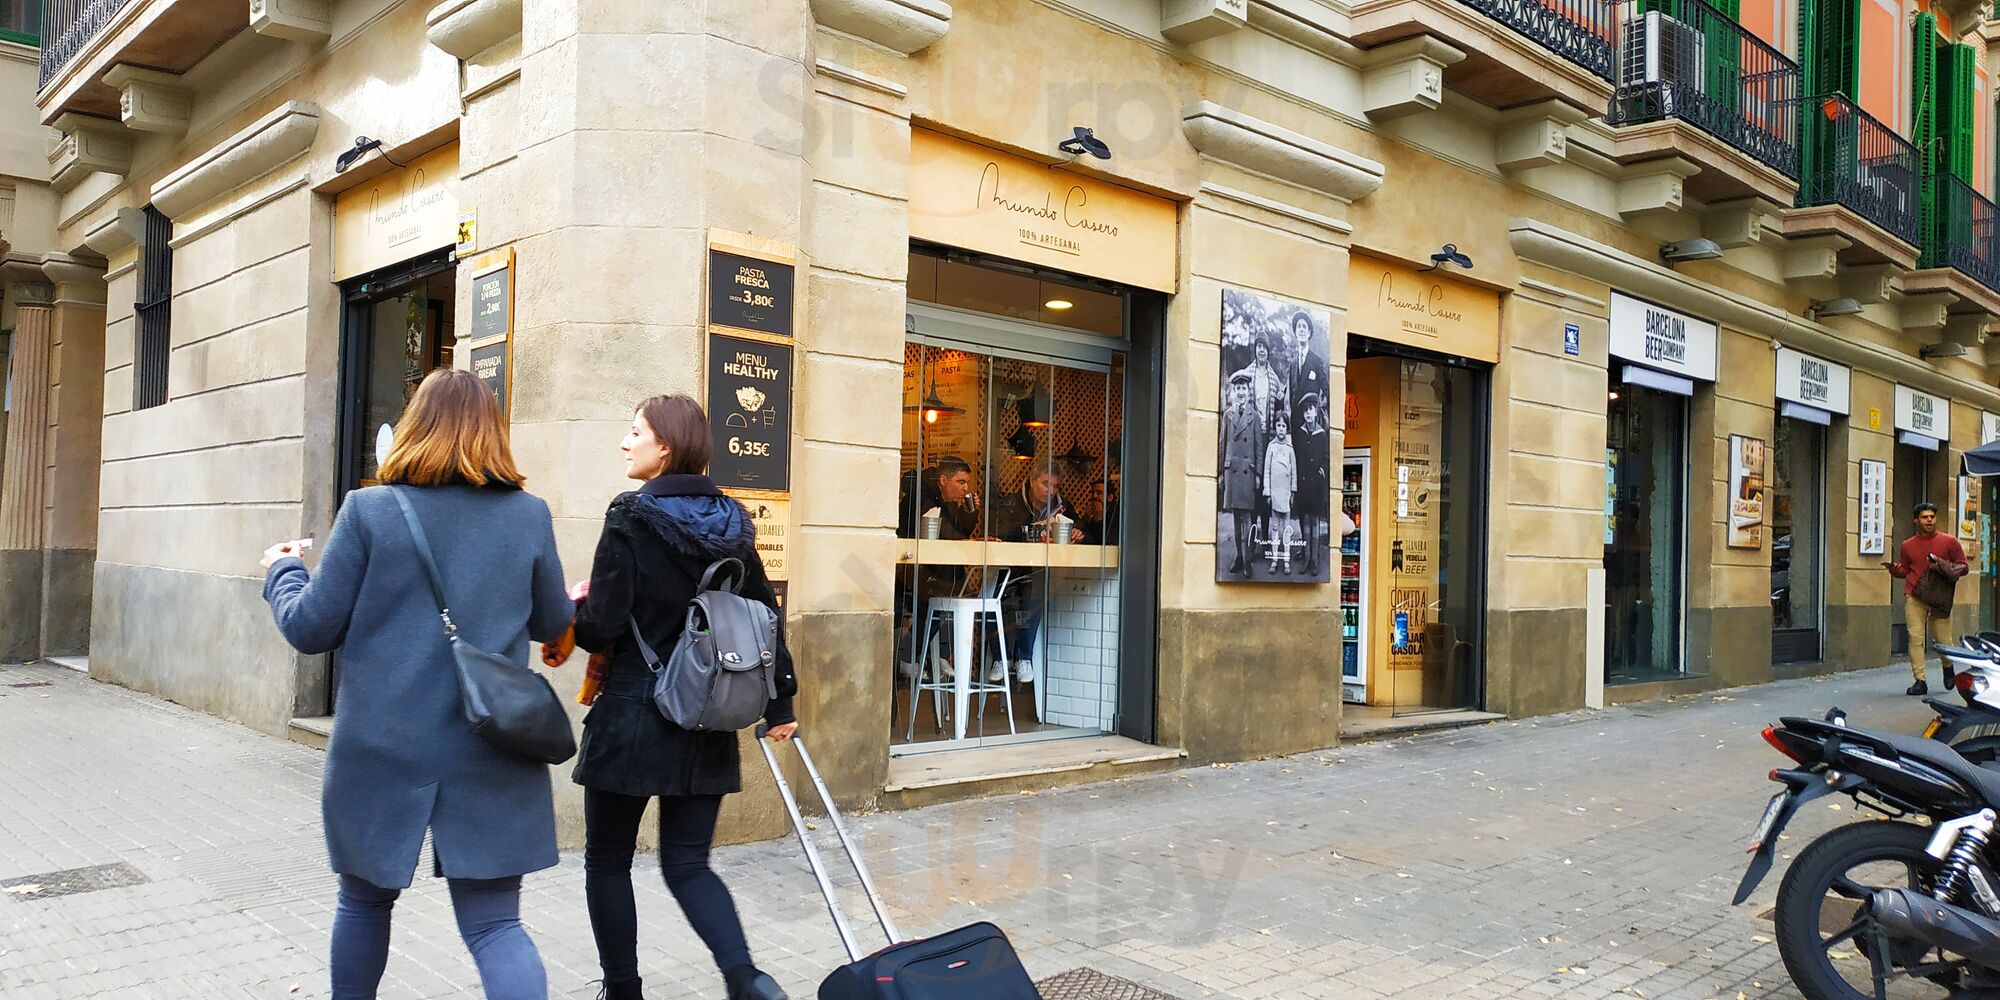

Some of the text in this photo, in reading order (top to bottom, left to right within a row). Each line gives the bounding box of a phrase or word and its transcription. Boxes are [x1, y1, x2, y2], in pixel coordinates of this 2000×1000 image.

[368, 168, 444, 236] Mundo Casero
[976, 162, 1119, 237] Mundo Casero
[1018, 228, 1081, 251] 100% ARTESANAL
[735, 274, 770, 290] FRESCA
[739, 266, 765, 280] PASTA
[743, 289, 775, 308] 3,80€
[1378, 271, 1462, 322] Mundo Casero
[1645, 309, 1685, 343] BARCELONA
[1645, 334, 1685, 362] BEER COMPANY
[474, 355, 502, 371] EMPANADA
[735, 351, 767, 368] MENU
[478, 366, 497, 379] BREAK
[723, 362, 779, 381] HEALTHY
[941, 367, 961, 375] PASTA
[1800, 357, 1828, 383] BARCELONA
[1799, 379, 1812, 401] BEER
[728, 436, 770, 458] 6,35€
[1405, 565, 1427, 575] BEEF
[1390, 589, 1427, 608] COMIDA
